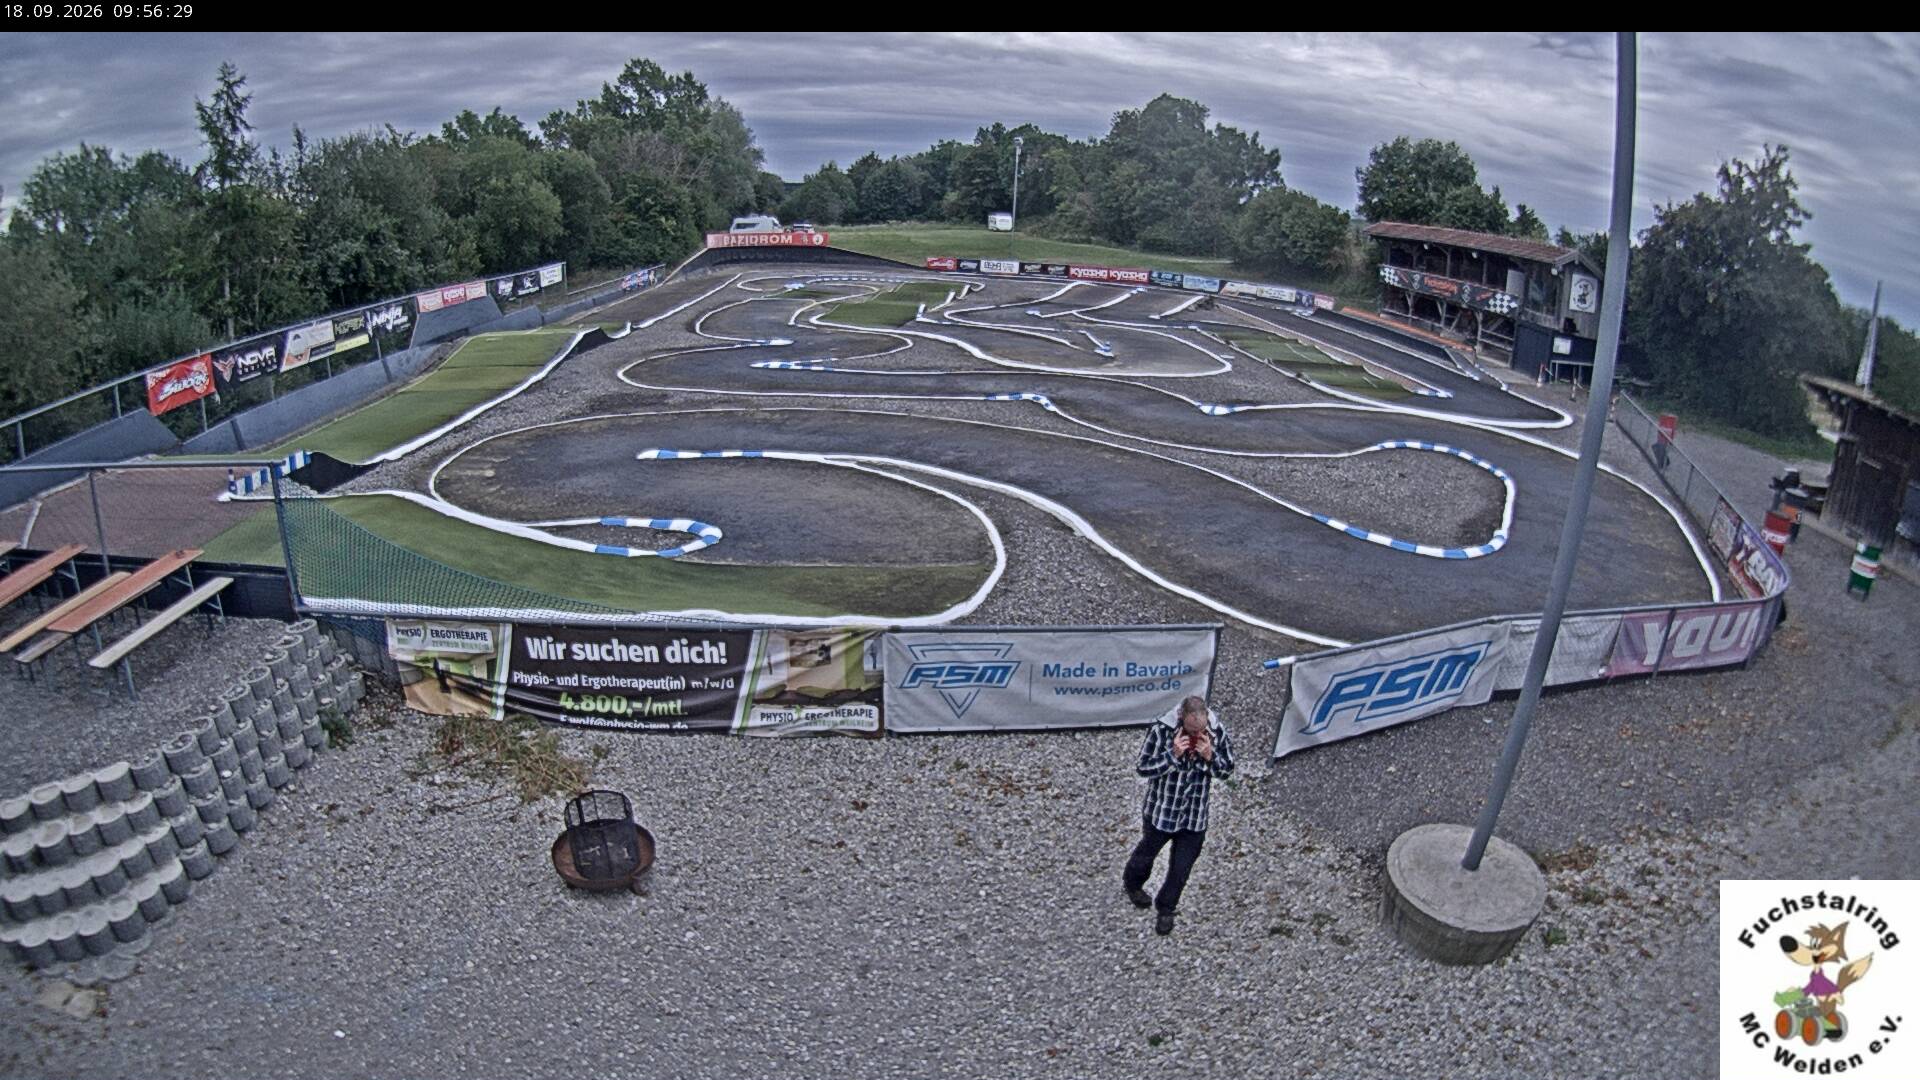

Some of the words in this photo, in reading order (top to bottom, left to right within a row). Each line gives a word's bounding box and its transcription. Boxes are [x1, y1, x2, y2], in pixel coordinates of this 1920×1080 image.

[430, 629, 488, 641] ERGOTHERAPIE
[525, 636, 567, 660] Wir
[572, 638, 660, 663] suchen
[665, 638, 728, 665] dich!
[906, 663, 1017, 688] PSM
[1042, 662, 1097, 678] Made
[1103, 662, 1119, 677] in
[1125, 660, 1193, 677] Bavaria
[513, 671, 554, 687] Physio-
[556, 674, 579, 687] und
[581, 674, 686, 692] Ergotherapeut(in)
[691, 678, 735, 690] m/w/d
[1054, 678, 1182, 697] www.psmco.de
[1309, 648, 1486, 728] PSM
[760, 711, 794, 722] PHYSIO
